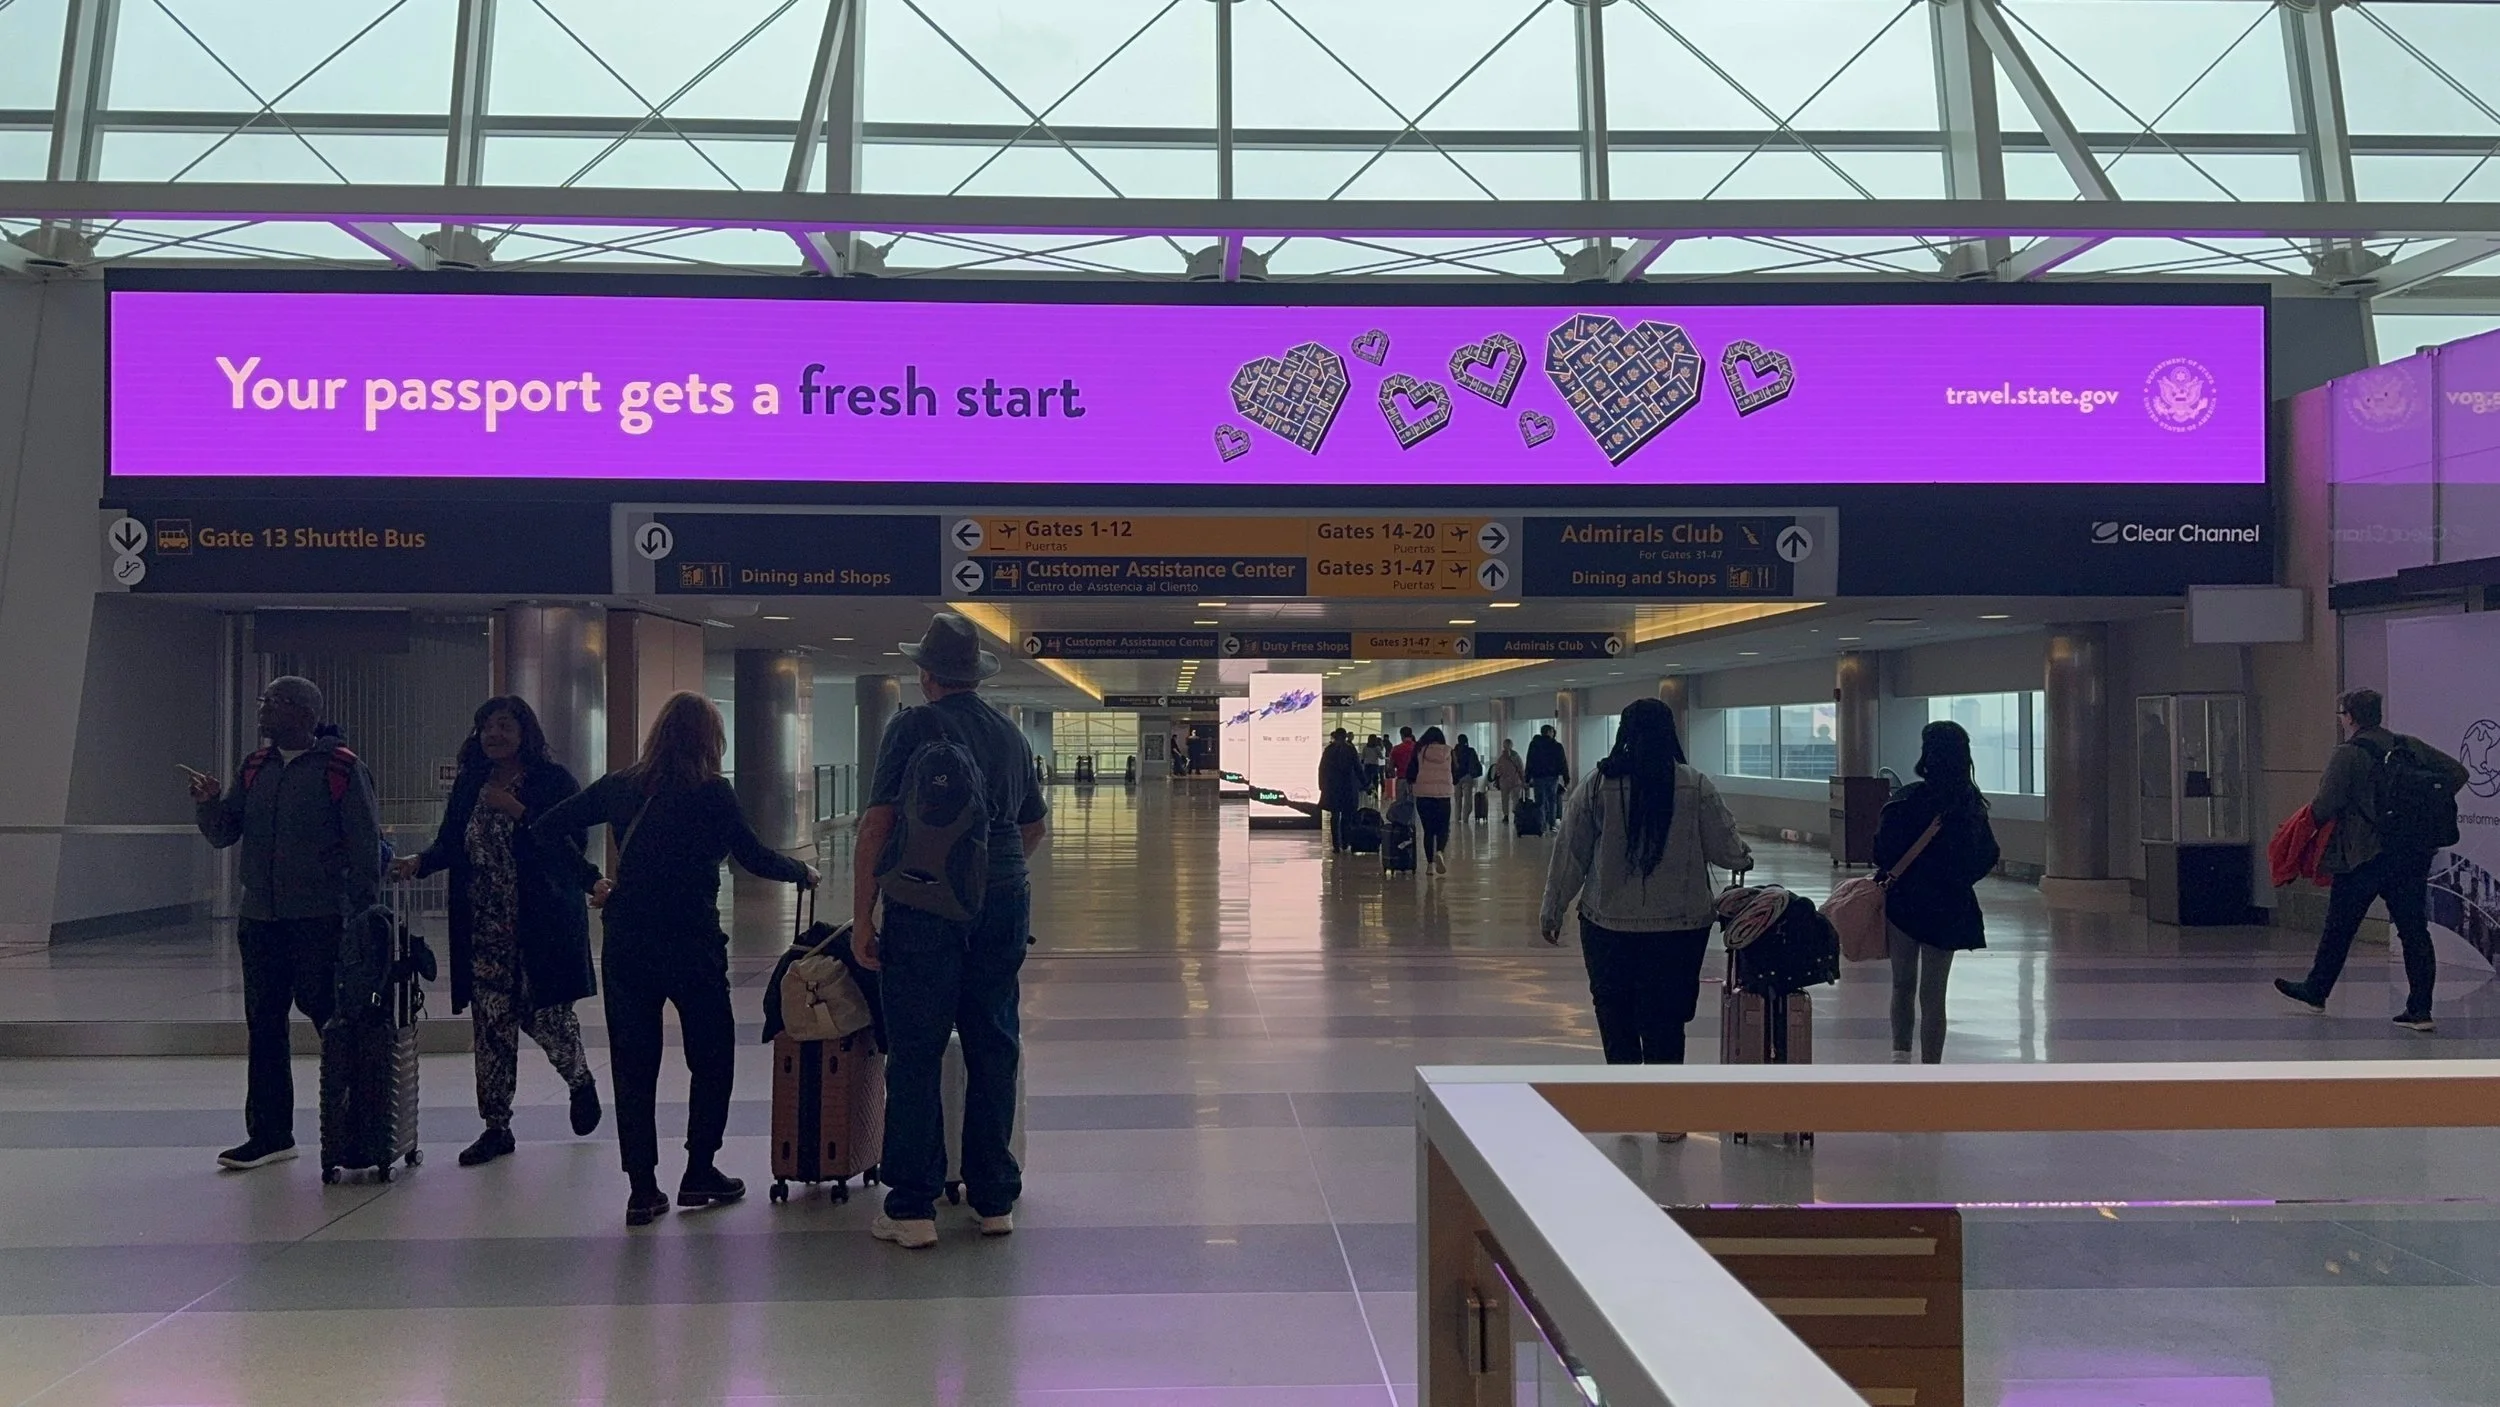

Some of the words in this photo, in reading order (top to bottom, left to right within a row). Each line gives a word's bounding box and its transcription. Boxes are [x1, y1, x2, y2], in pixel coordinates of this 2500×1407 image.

[216, 356, 346, 410] Your
[365, 372, 601, 432] passport
[619, 373, 734, 434] gets
[752, 383, 779, 415] a
[799, 363, 937, 416] fresh
[957, 378, 1086, 418] start
[1946, 382, 2119, 413] travel.state.gov
[1025, 521, 1083, 537] Gates
[1091, 521, 1132, 537] 1-12
[1317, 523, 1375, 539] Gates
[1382, 523, 1436, 539] 14-20
[1560, 524, 1664, 543] Admirals
[1672, 524, 1723, 543] Club
[2122, 524, 2176, 542] Clear
[2179, 524, 2260, 542] Channel
[199, 528, 254, 547] Gate
[262, 528, 288, 547] 13
[294, 528, 379, 547] Shuttle
[385, 528, 425, 547] Bus
[1025, 541, 1068, 551] Puertas
[1393, 544, 1436, 554] Puertas
[1639, 550, 1656, 560] For
[1661, 550, 1692, 560] Gates
[1696, 550, 1723, 560] 31-47
[1027, 561, 1120, 577] Customer
[1126, 561, 1226, 578] Assistance
[1231, 561, 1296, 578] Center
[1317, 560, 1374, 576] Gates
[1380, 560, 1436, 576] 31-47
[742, 569, 798, 586] Dining
[803, 569, 835, 583] and
[840, 569, 891, 587] Shops
[1393, 580, 1435, 590] Puertas
[1572, 571, 1627, 588] Dining
[1631, 570, 1663, 584] and
[1667, 571, 1717, 587] Shops
[1027, 582, 1065, 592] Centro
[1068, 581, 1083, 592] de
[1087, 582, 1143, 592] Asistencia
[1146, 581, 1156, 592] al
[1065, 637, 1116, 647] Customer
[1120, 636, 1177, 648] Assistance
[1179, 637, 1216, 648] Center
[1262, 641, 1289, 653] Duty
[1291, 641, 1315, 652] Free
[1316, 641, 1349, 653] Shops
[1370, 637, 1400, 647] Gates
[1402, 637, 1431, 647] 31-47
[1504, 640, 1556, 651] Admirals
[1558, 640, 1584, 651] Club
[1260, 792, 1278, 800] hulu
